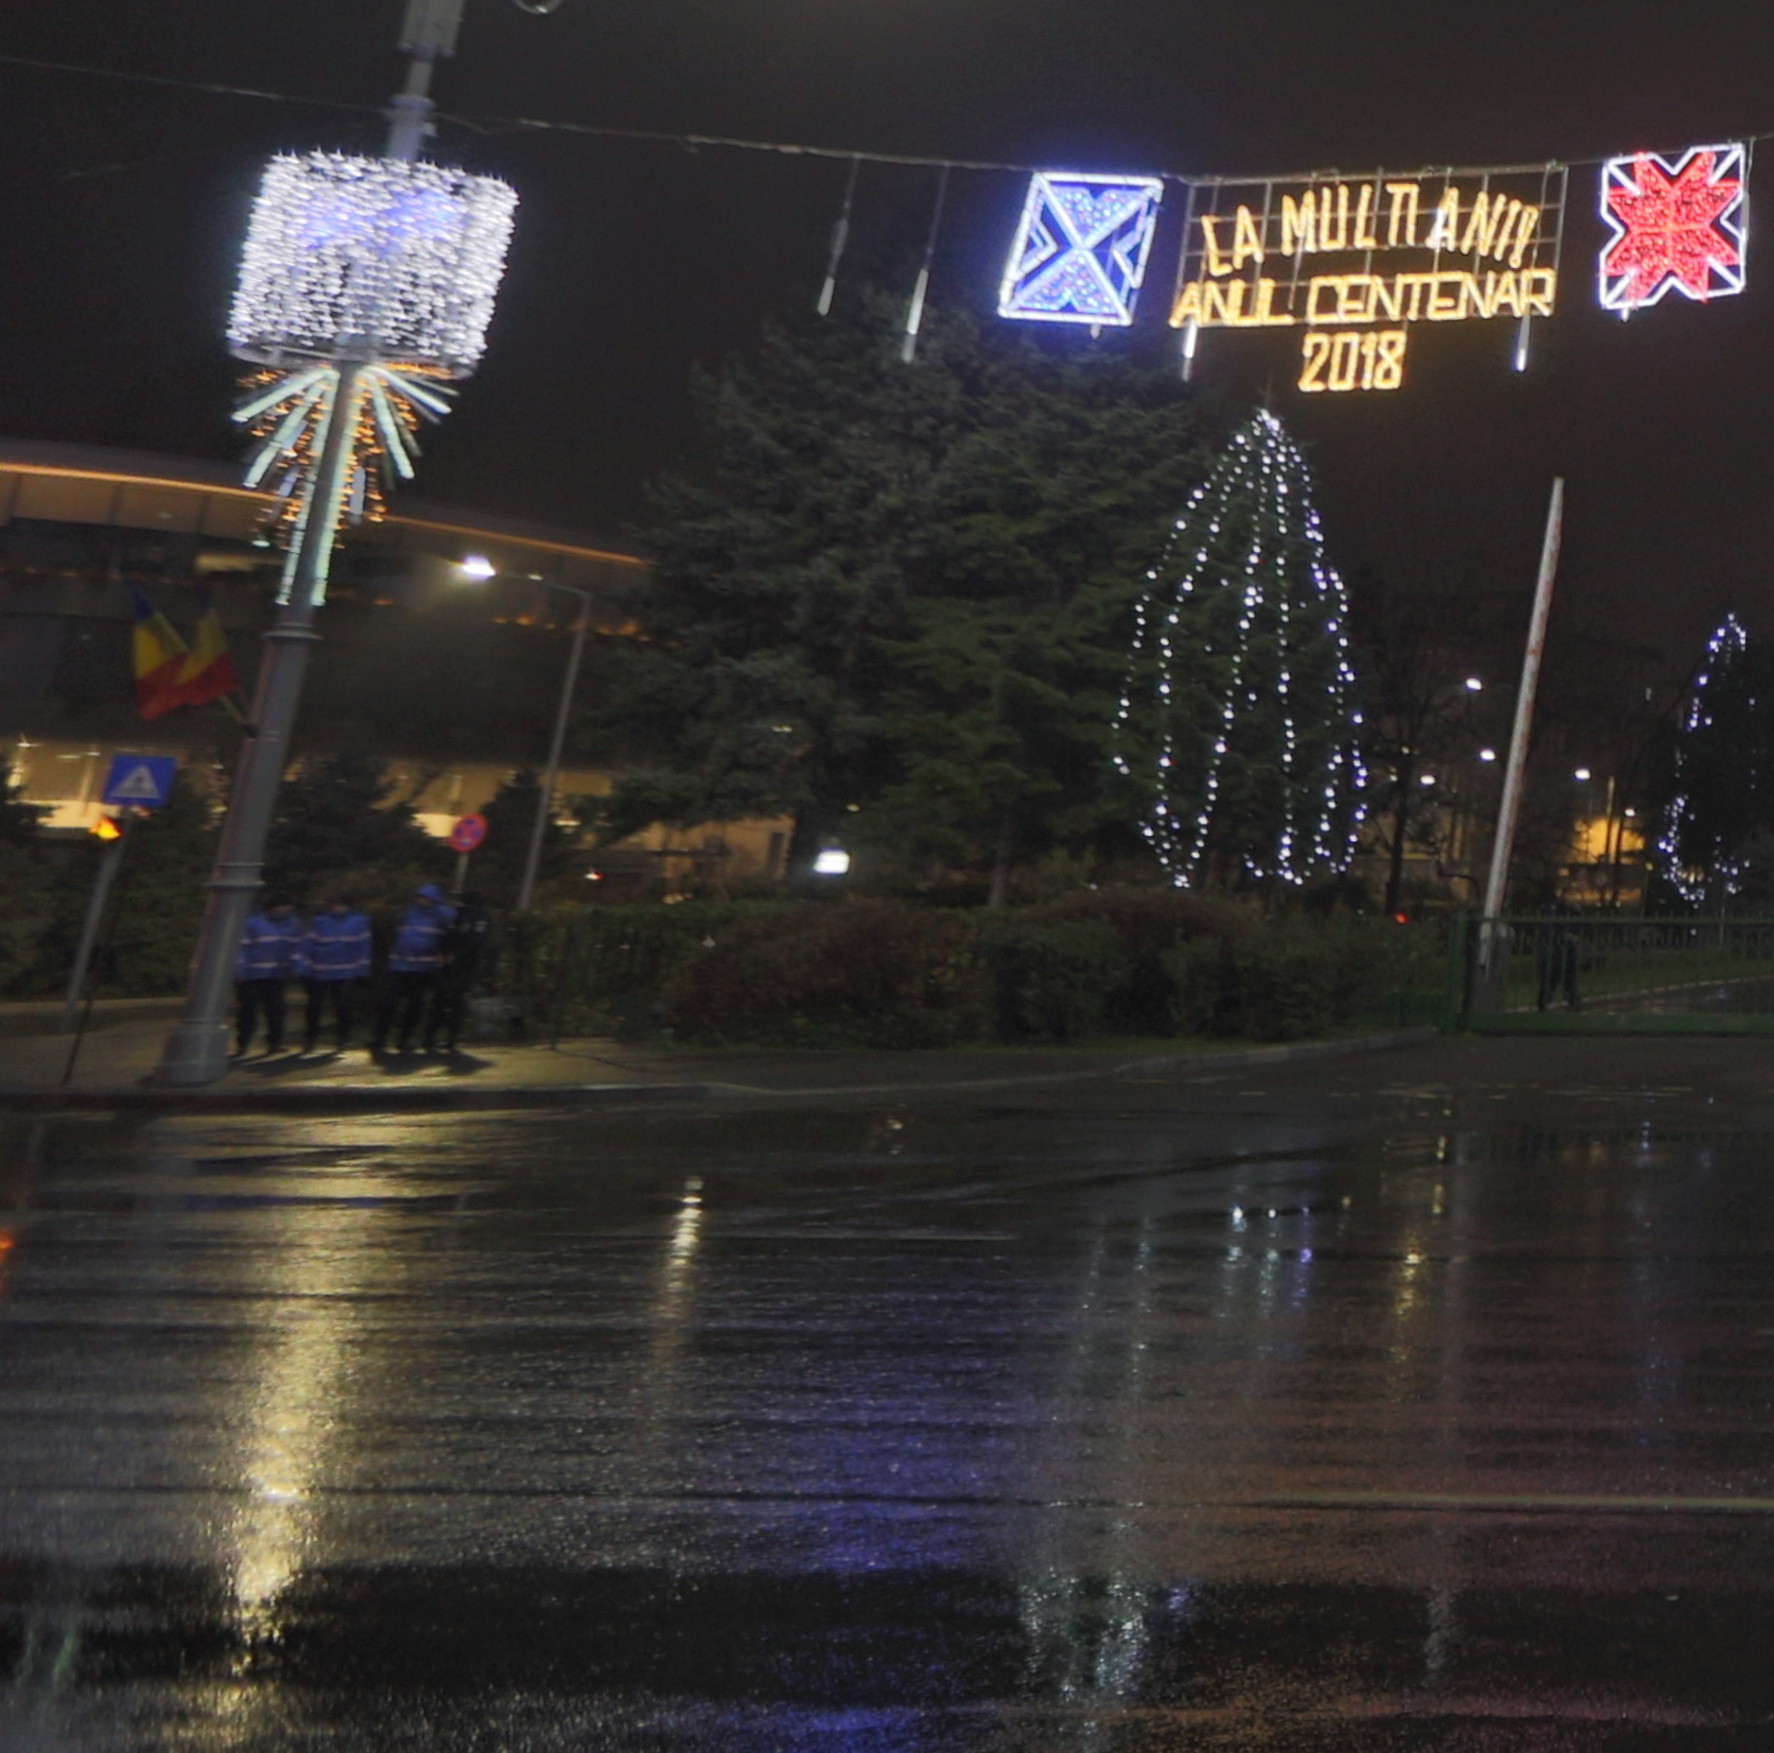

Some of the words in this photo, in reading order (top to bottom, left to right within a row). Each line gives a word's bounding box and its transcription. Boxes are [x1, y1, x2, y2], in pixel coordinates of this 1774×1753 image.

[1201, 205, 1264, 276] LA
[1281, 183, 1419, 256] MULTI
[1168, 279, 1295, 328] ANUL
[1306, 268, 1556, 323] CENTENAR
[1298, 330, 1407, 392] 2018
